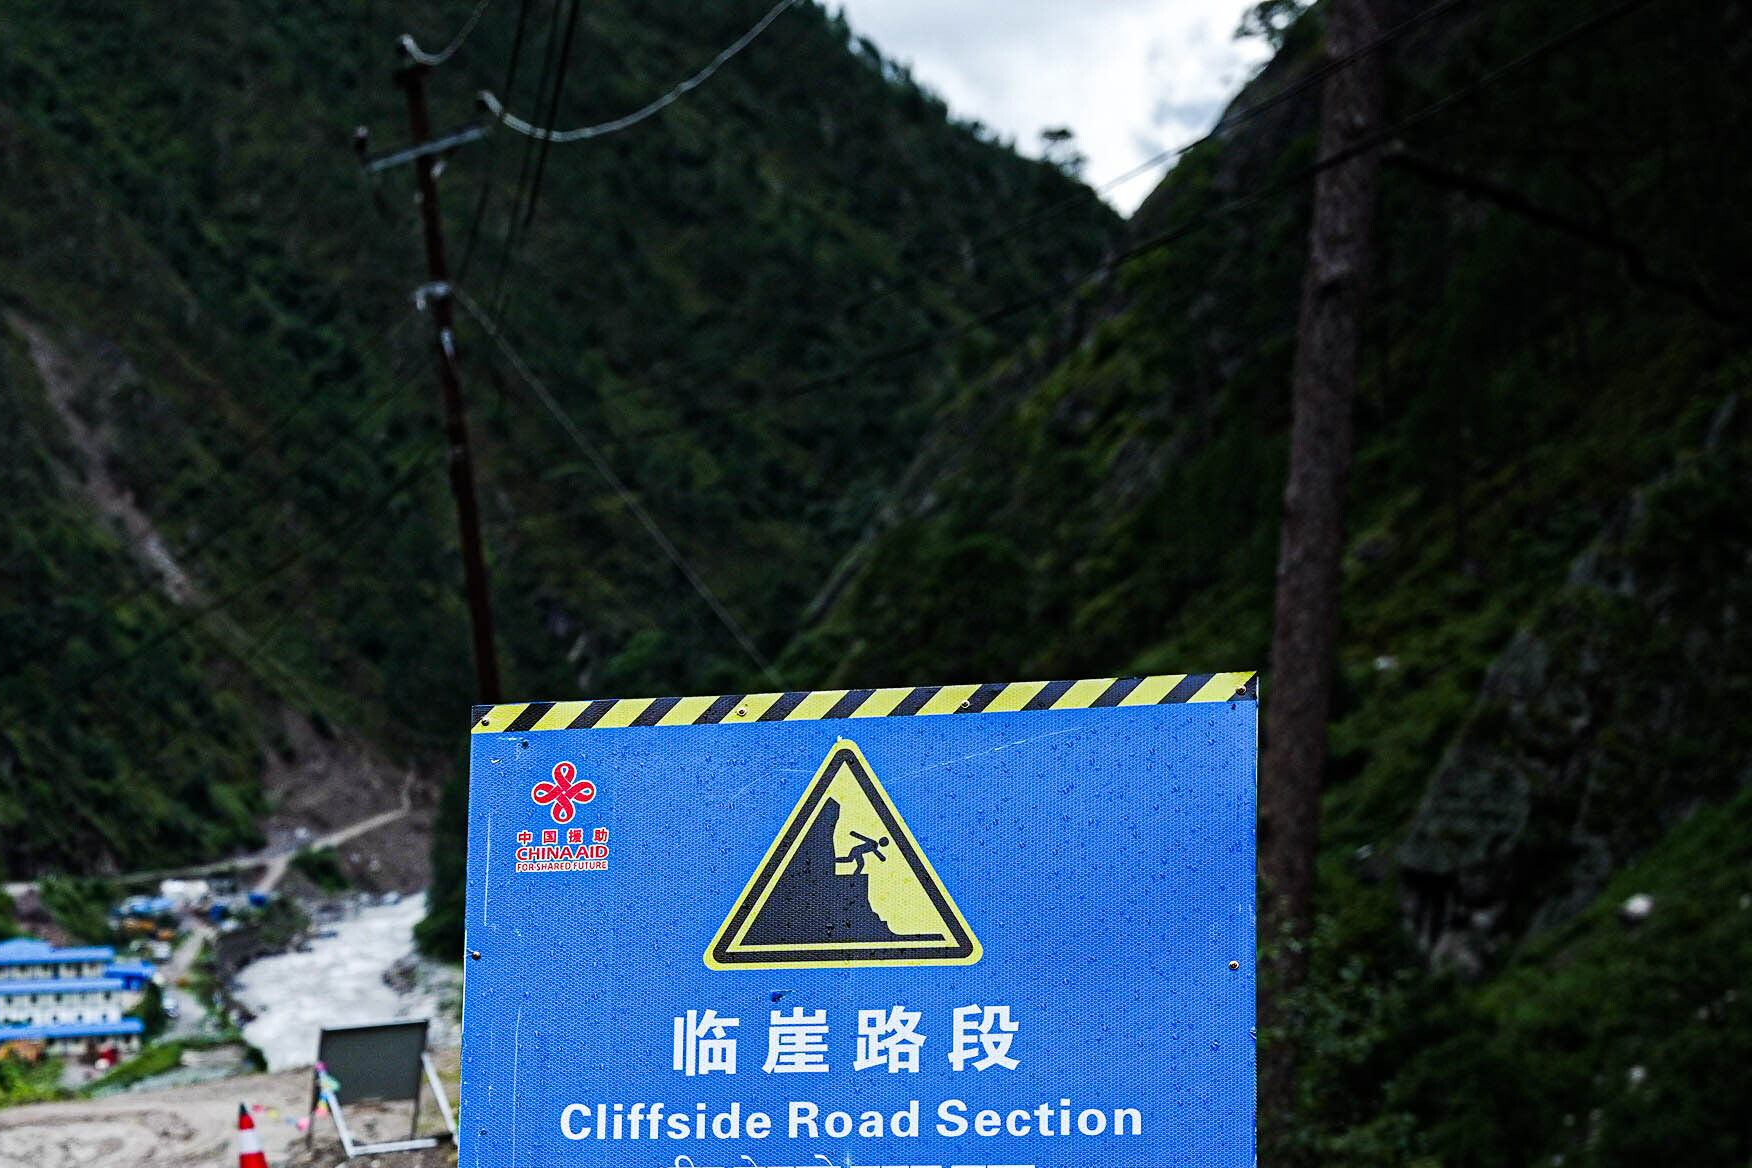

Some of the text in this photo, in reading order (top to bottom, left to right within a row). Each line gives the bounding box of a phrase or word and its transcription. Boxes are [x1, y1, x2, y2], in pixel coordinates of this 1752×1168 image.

[517, 828, 608, 845] 中国援助
[516, 845, 608, 861] CHINA AID
[517, 861, 607, 872] FOR SHARED FUTURE
[672, 1004, 1020, 1076] 临崖路段
[559, 1098, 1143, 1140] Cliffside Road Section
